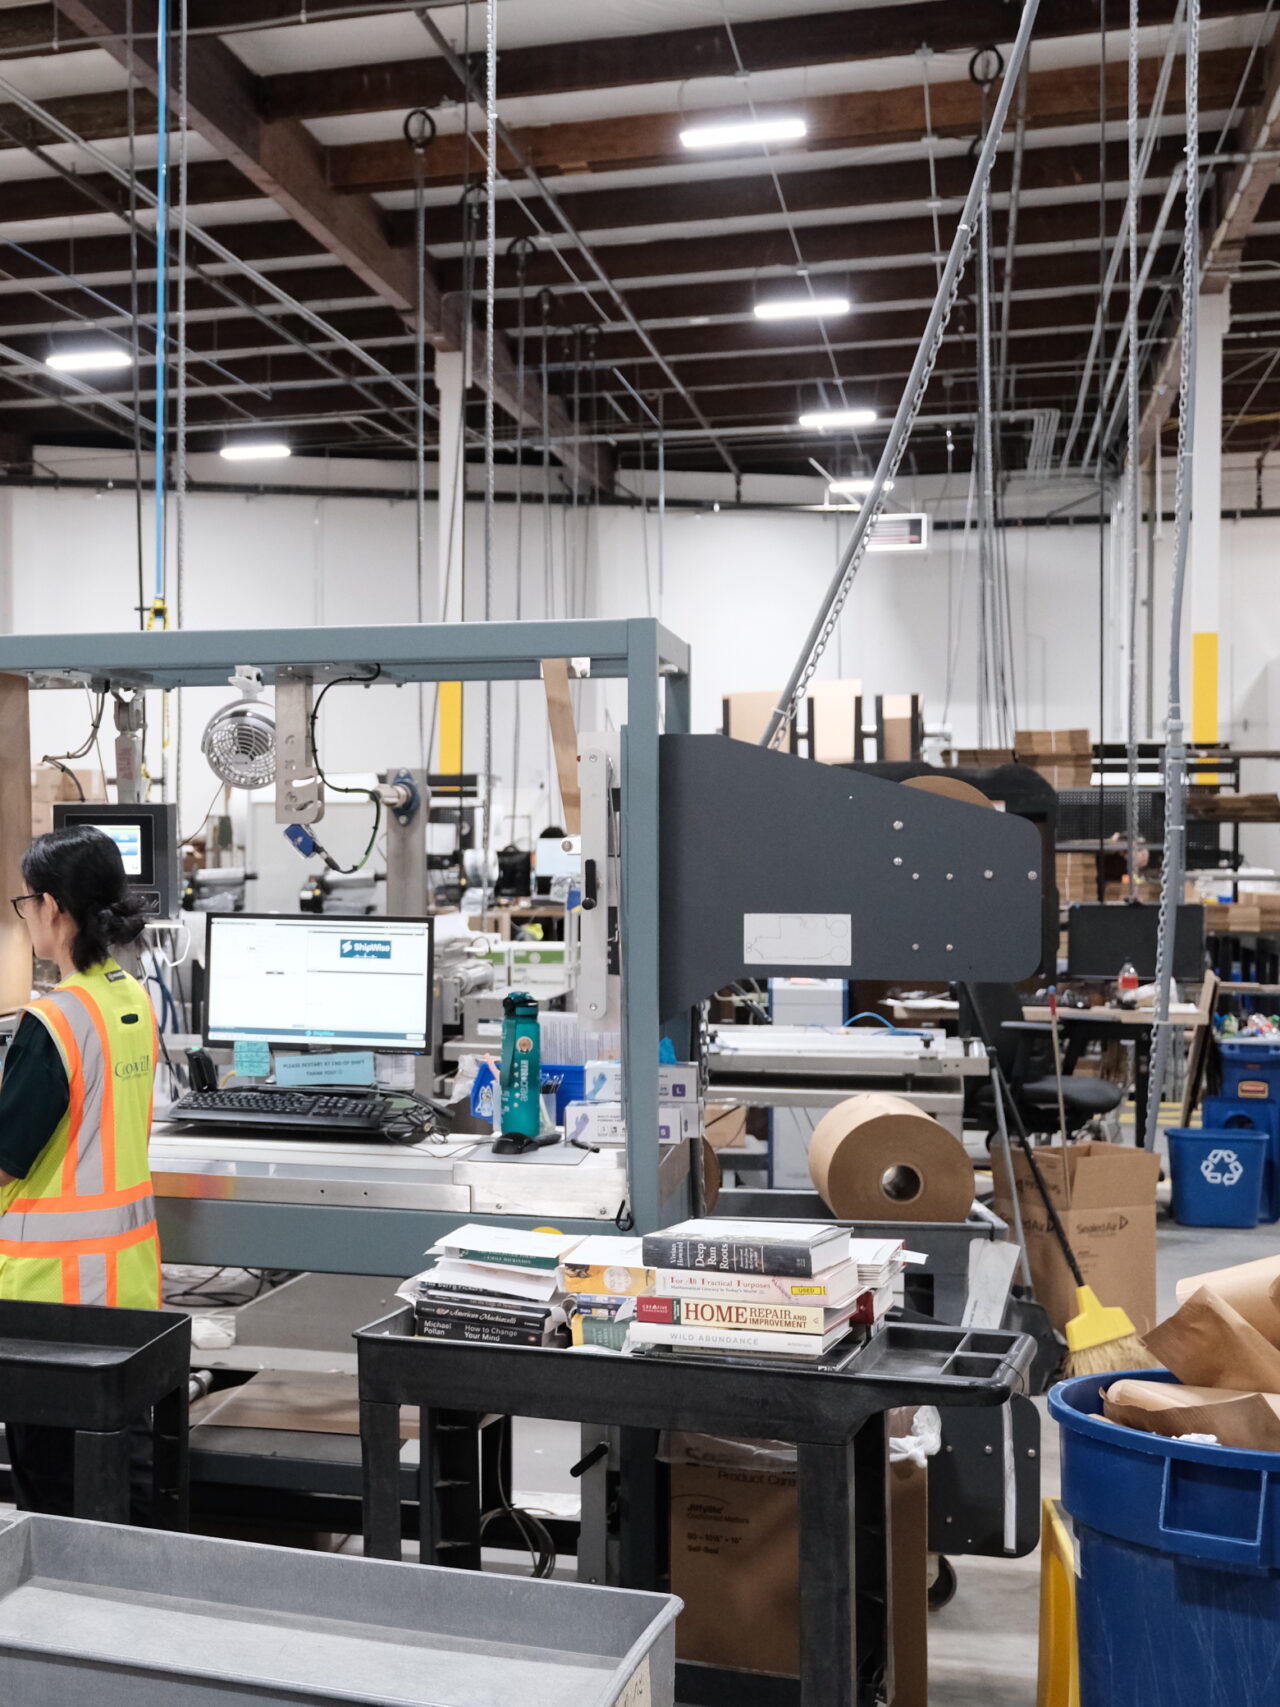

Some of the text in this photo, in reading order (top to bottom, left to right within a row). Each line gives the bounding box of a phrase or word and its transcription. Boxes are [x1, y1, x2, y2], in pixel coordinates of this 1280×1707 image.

[354, 942, 391, 953] ShipWise
[676, 1242, 684, 1266] Howard
[695, 1243, 706, 1267] Deep
[708, 1246, 716, 1266] Run
[720, 1243, 729, 1270] Roots
[671, 1276, 771, 1290] For All Practical Purposes
[684, 1302, 748, 1324] HOME
[749, 1308, 792, 1320] REPAIR
[793, 1314, 807, 1322] AND
[424, 1320, 452, 1330] Michael
[464, 1324, 481, 1332] How
[490, 1327, 518, 1336] Change
[749, 1318, 807, 1328] IMPROVEMENT
[424, 1327, 445, 1336] Pollan
[464, 1332, 500, 1342] Your Mind
[670, 1332, 759, 1346] WILD ABUNDANCE
[718, 1470, 764, 1484] Product
